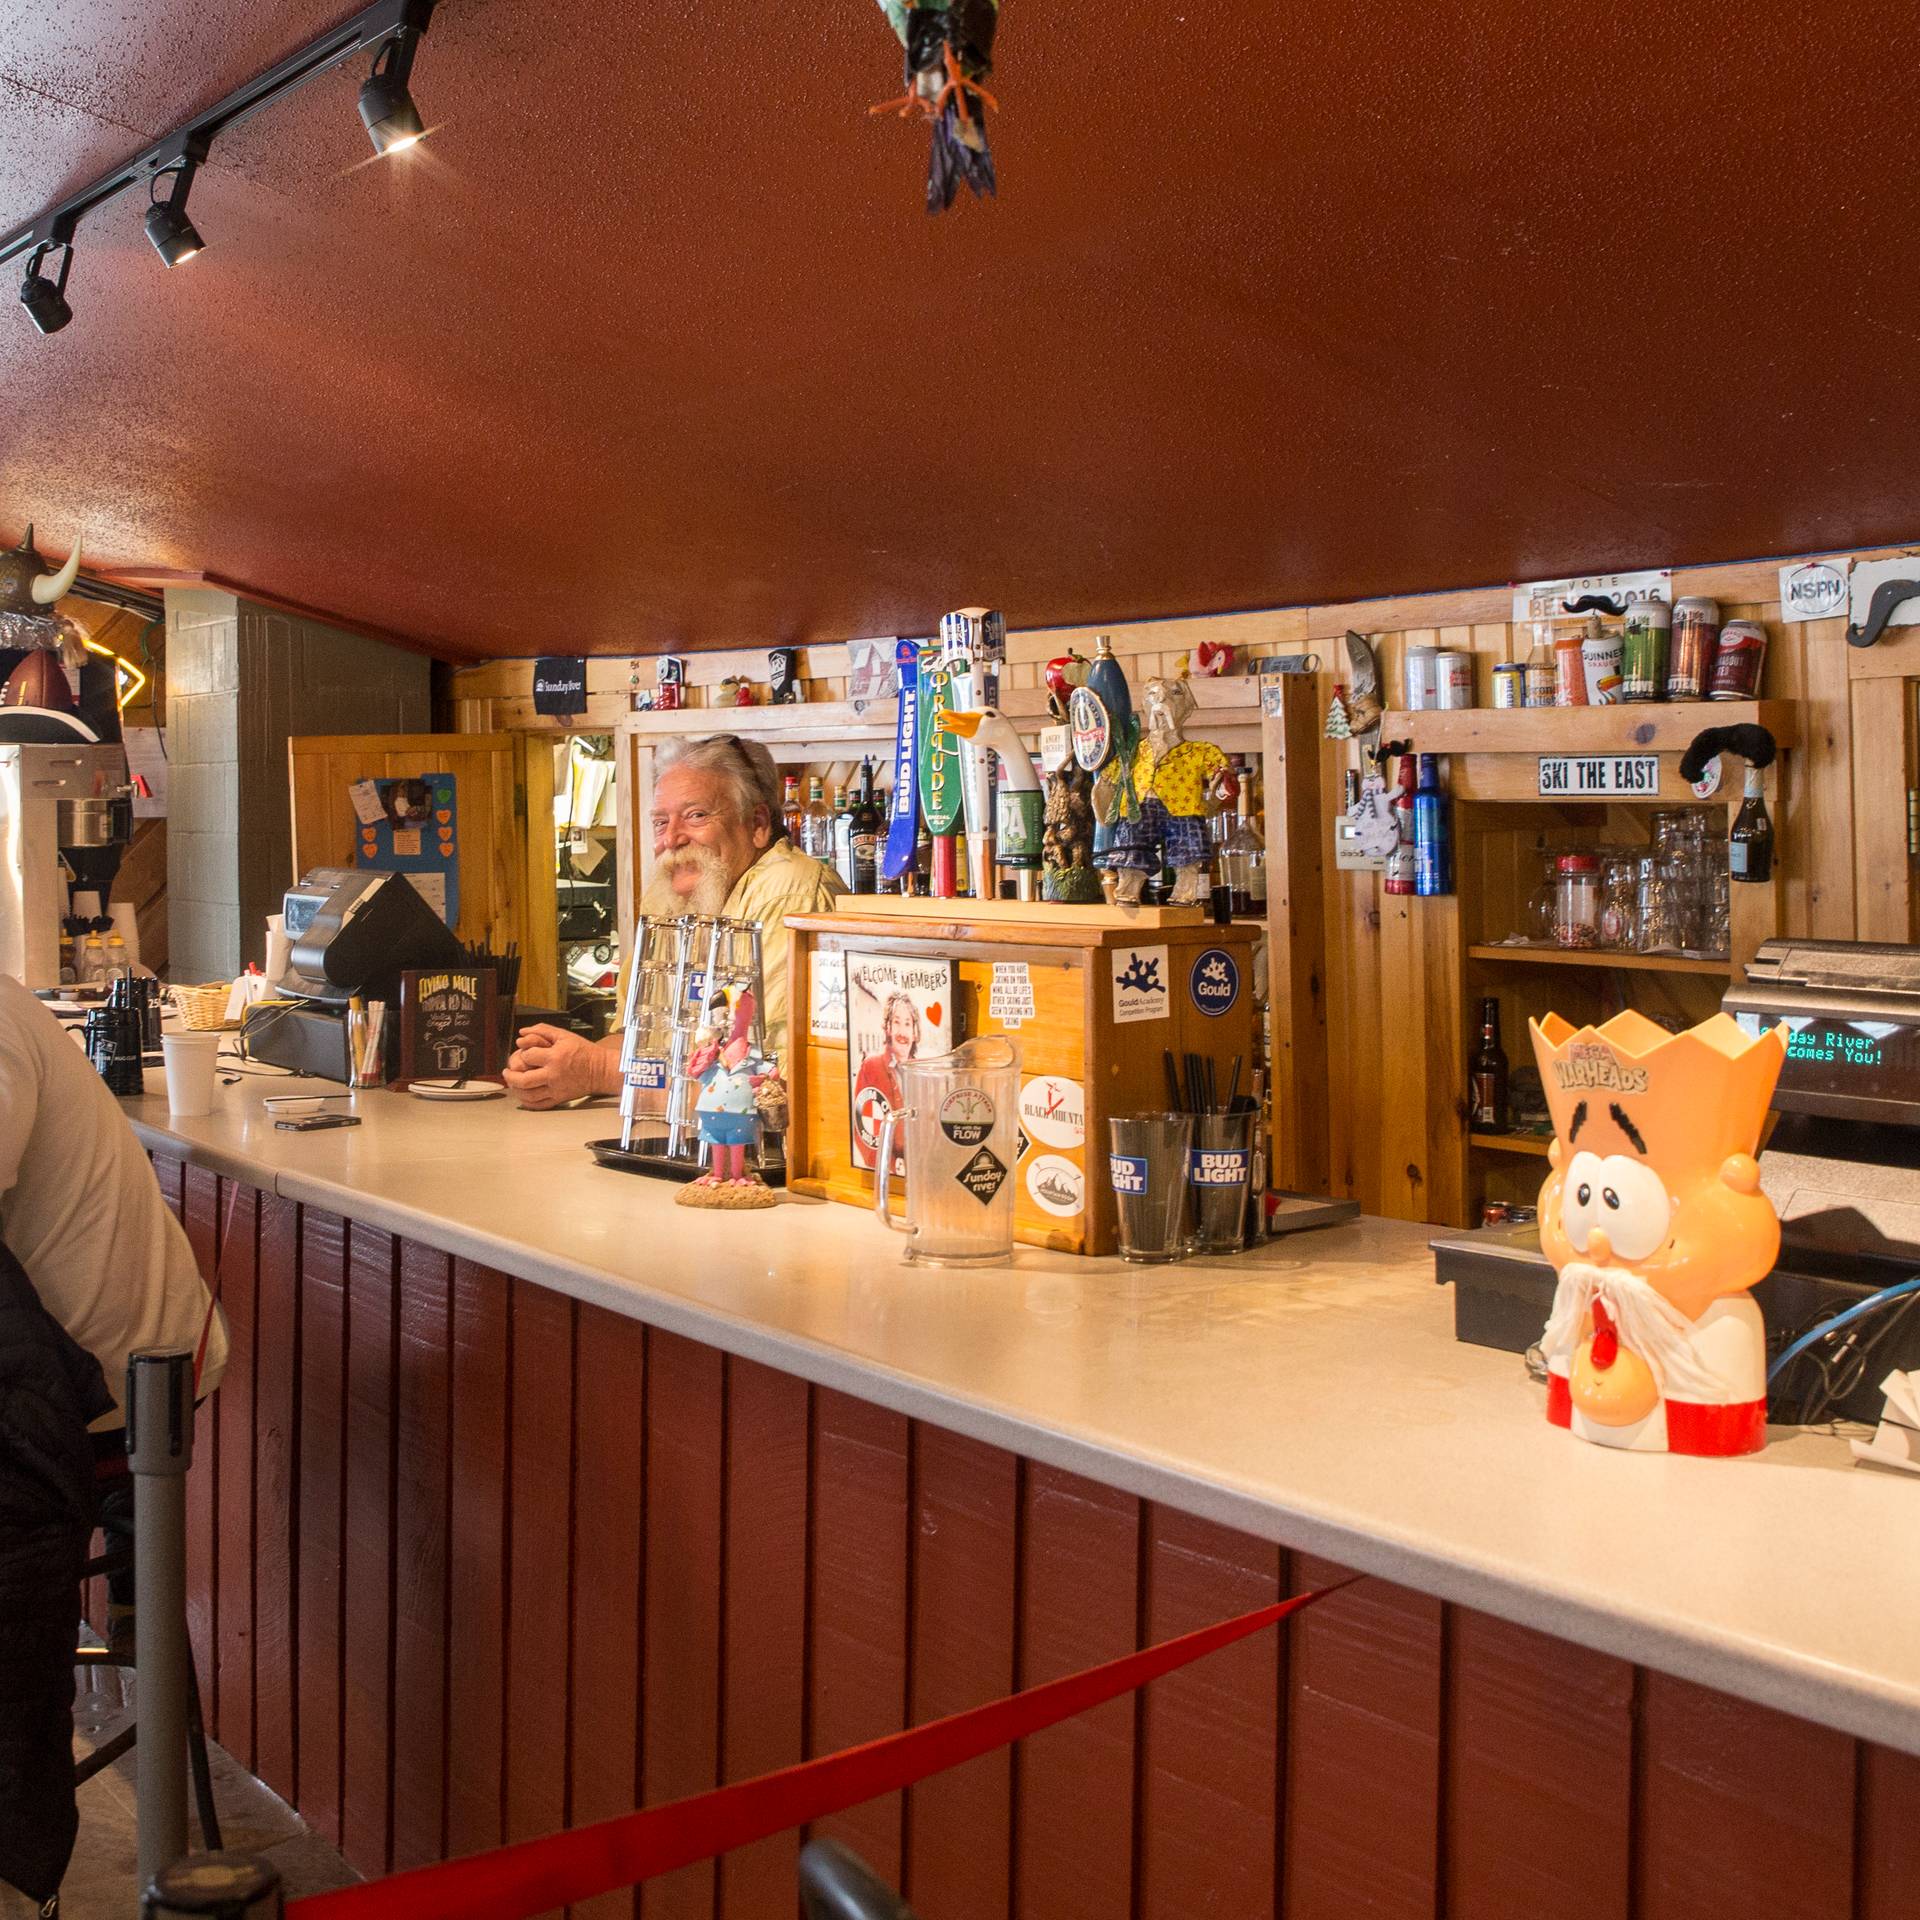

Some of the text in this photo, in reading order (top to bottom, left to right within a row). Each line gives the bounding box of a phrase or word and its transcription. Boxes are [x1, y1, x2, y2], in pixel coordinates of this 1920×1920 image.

[1568, 576, 1619, 592] VOTE
[1790, 579, 1840, 601] NSPN
[929, 671, 956, 811] PRELUDE
[898, 688, 916, 814] BUD LIGHT
[1541, 759, 1656, 790] SKI THE EAST
[855, 964, 948, 991] WELCOME MEMBERS
[453, 974, 478, 1001] MULE
[1197, 981, 1231, 997] Gould
[1118, 995, 1165, 1008] Gould Academy
[1825, 1032, 1875, 1050] River
[1844, 1048, 1882, 1065] You!
[1553, 1059, 1648, 1093] WARHEADS
[1024, 1103, 1049, 1119] BLACK
[952, 1129, 982, 1140] FLOW
[1201, 1153, 1243, 1169] BUD
[962, 1170, 1003, 1184] Sunday
[1193, 1165, 1248, 1183] LIGHT
[972, 1181, 996, 1193] river
